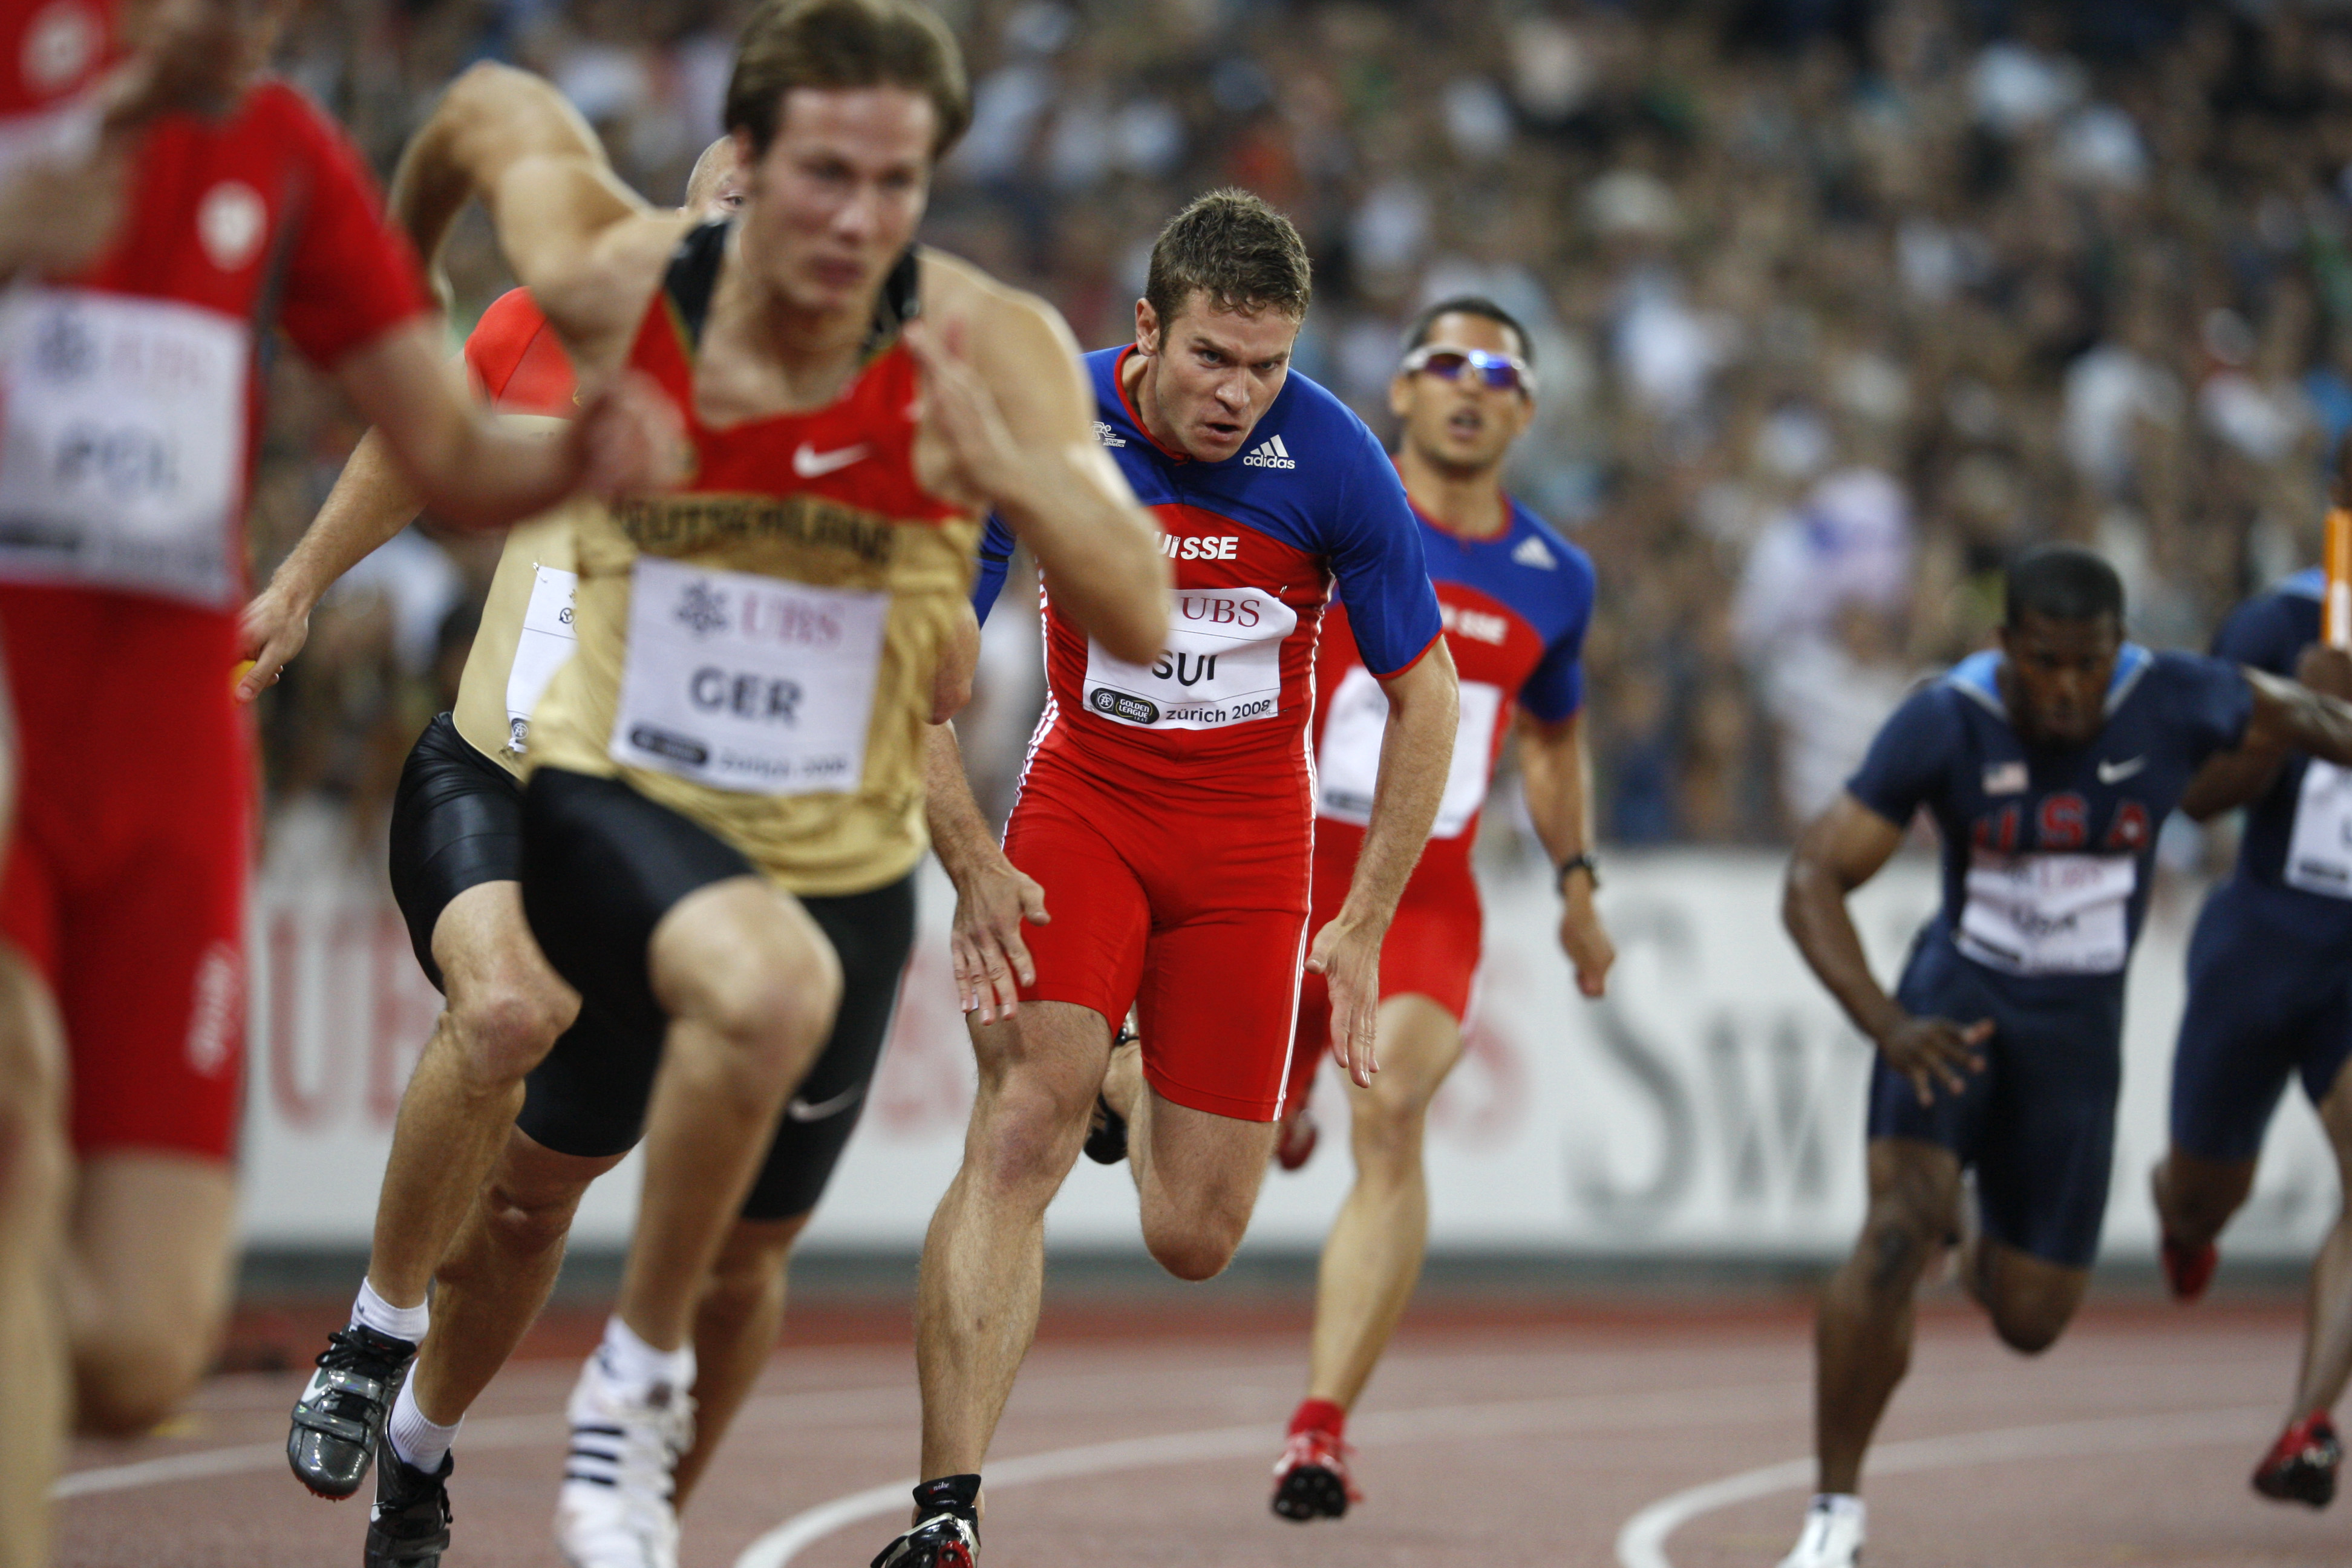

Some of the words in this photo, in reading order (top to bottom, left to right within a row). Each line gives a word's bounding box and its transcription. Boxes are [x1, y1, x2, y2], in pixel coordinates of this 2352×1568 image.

[1243, 455, 1296, 469] adidas
[741, 591, 843, 648] UBS
[1181, 597, 1261, 627] UBS
[1151, 649, 1218, 687] SUI
[688, 666, 802, 728] GER
[1119, 705, 1148, 719] LEAGUE
[1120, 699, 1149, 713] GOLDEN
[1166, 708, 1226, 722] zürich
[1232, 699, 1271, 720] 2008
[1971, 794, 2149, 853] USA
